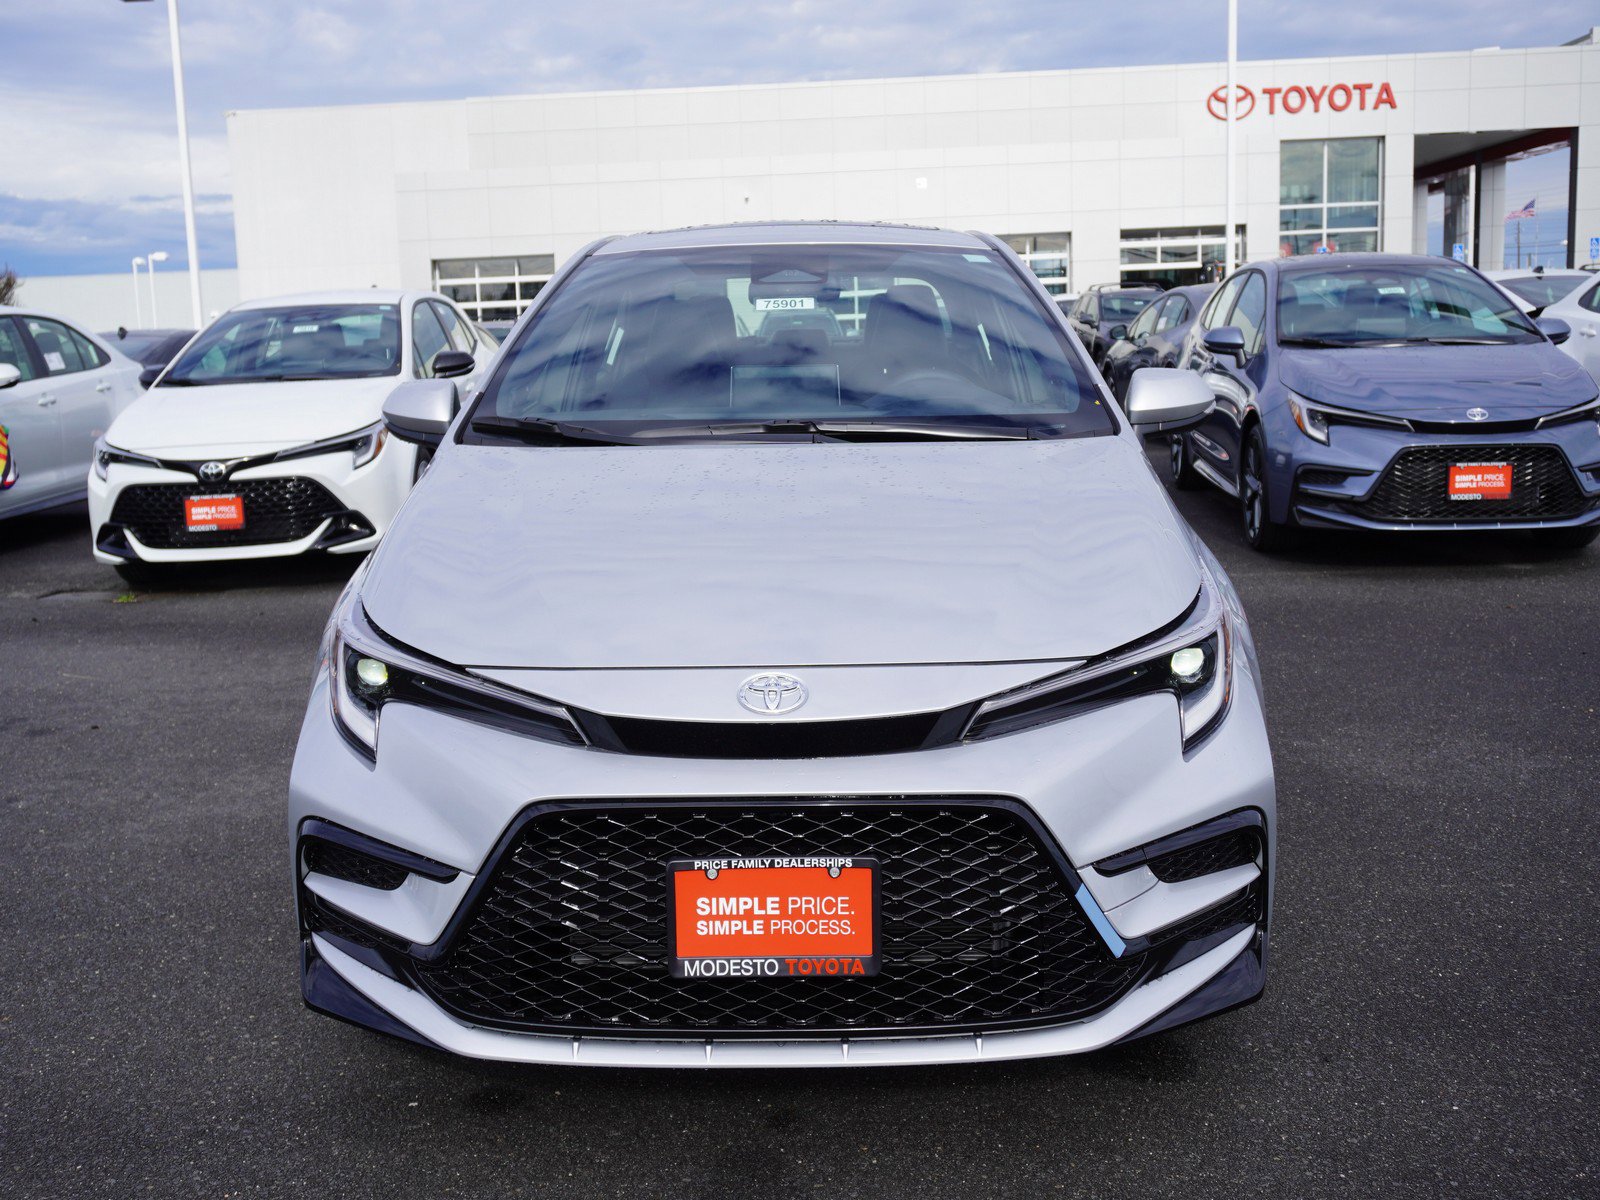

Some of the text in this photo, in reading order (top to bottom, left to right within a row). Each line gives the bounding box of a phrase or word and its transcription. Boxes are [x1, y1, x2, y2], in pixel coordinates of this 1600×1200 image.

[1262, 82, 1398, 114] TOYOTA
[764, 299, 804, 308] 75901
[694, 858, 853, 870] PRICE FAMILY DEALERSHIPS
[696, 896, 855, 916] SIMPLE PRICE.
[696, 919, 855, 936] SIMPLE PROCESS.
[684, 959, 865, 977] MODESTO TOYOTA
